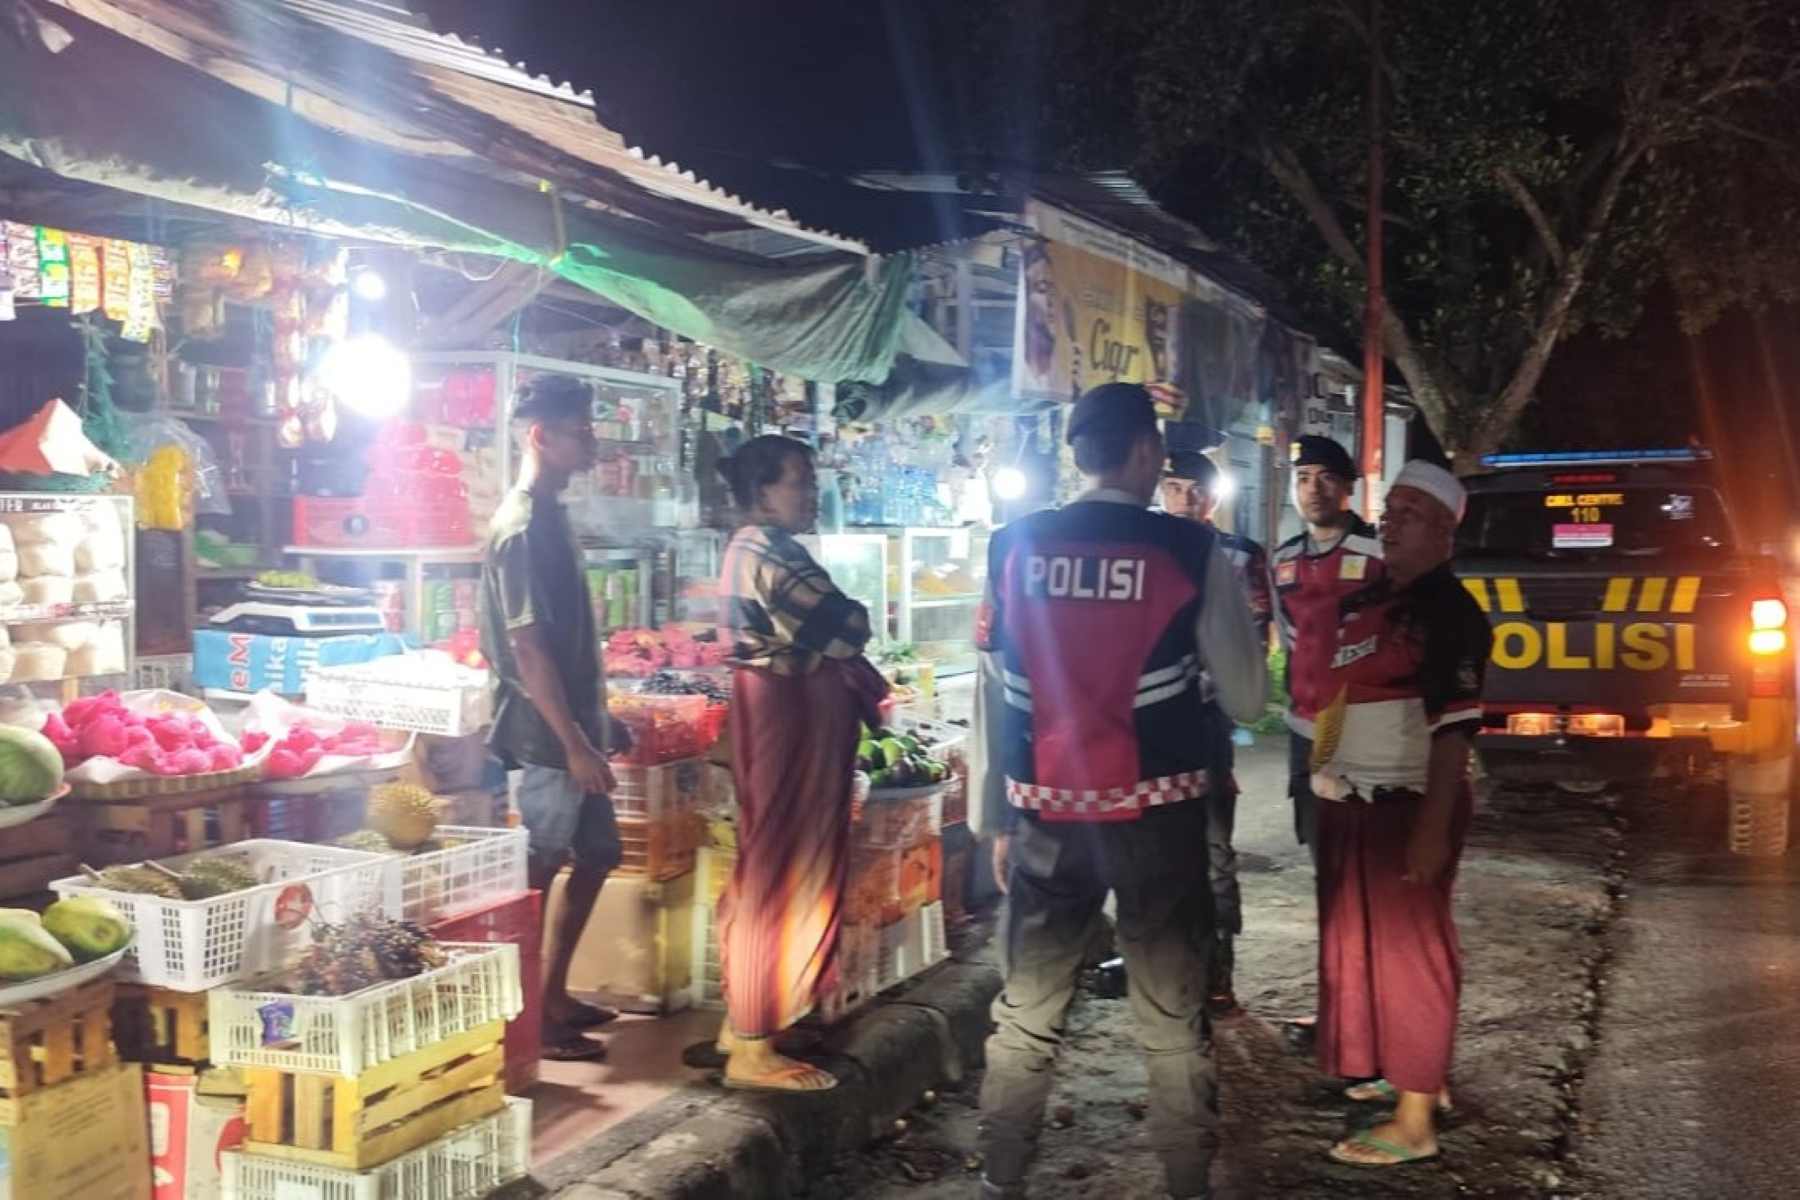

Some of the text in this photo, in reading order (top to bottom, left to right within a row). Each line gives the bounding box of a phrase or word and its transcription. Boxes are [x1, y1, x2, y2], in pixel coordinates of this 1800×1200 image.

[1571, 507, 1600, 522] 110
[1024, 556, 1146, 600] POLISI
[1490, 622, 1695, 670] OLISI
